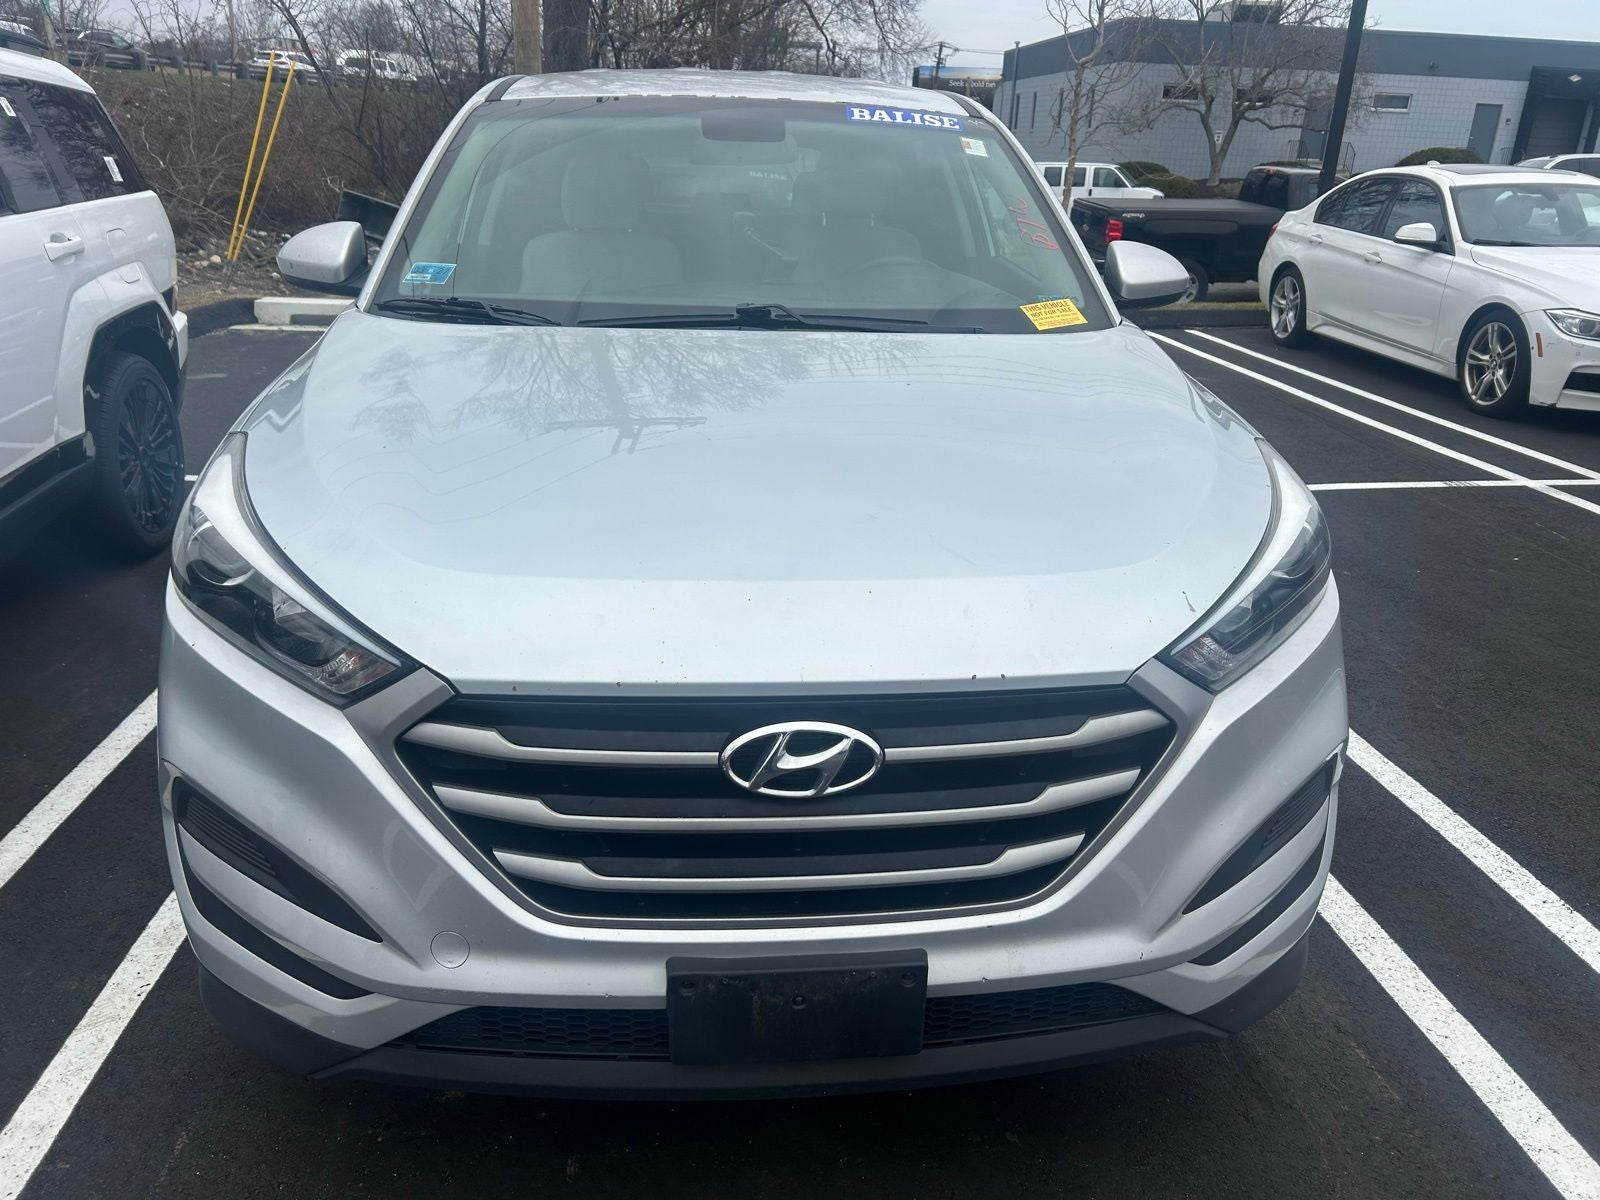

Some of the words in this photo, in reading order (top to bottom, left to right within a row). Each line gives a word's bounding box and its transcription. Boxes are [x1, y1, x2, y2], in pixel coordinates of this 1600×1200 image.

[850, 107, 960, 129] BALISE
[1023, 304, 1042, 313] THIS
[1041, 301, 1071, 310] VEHICLE
